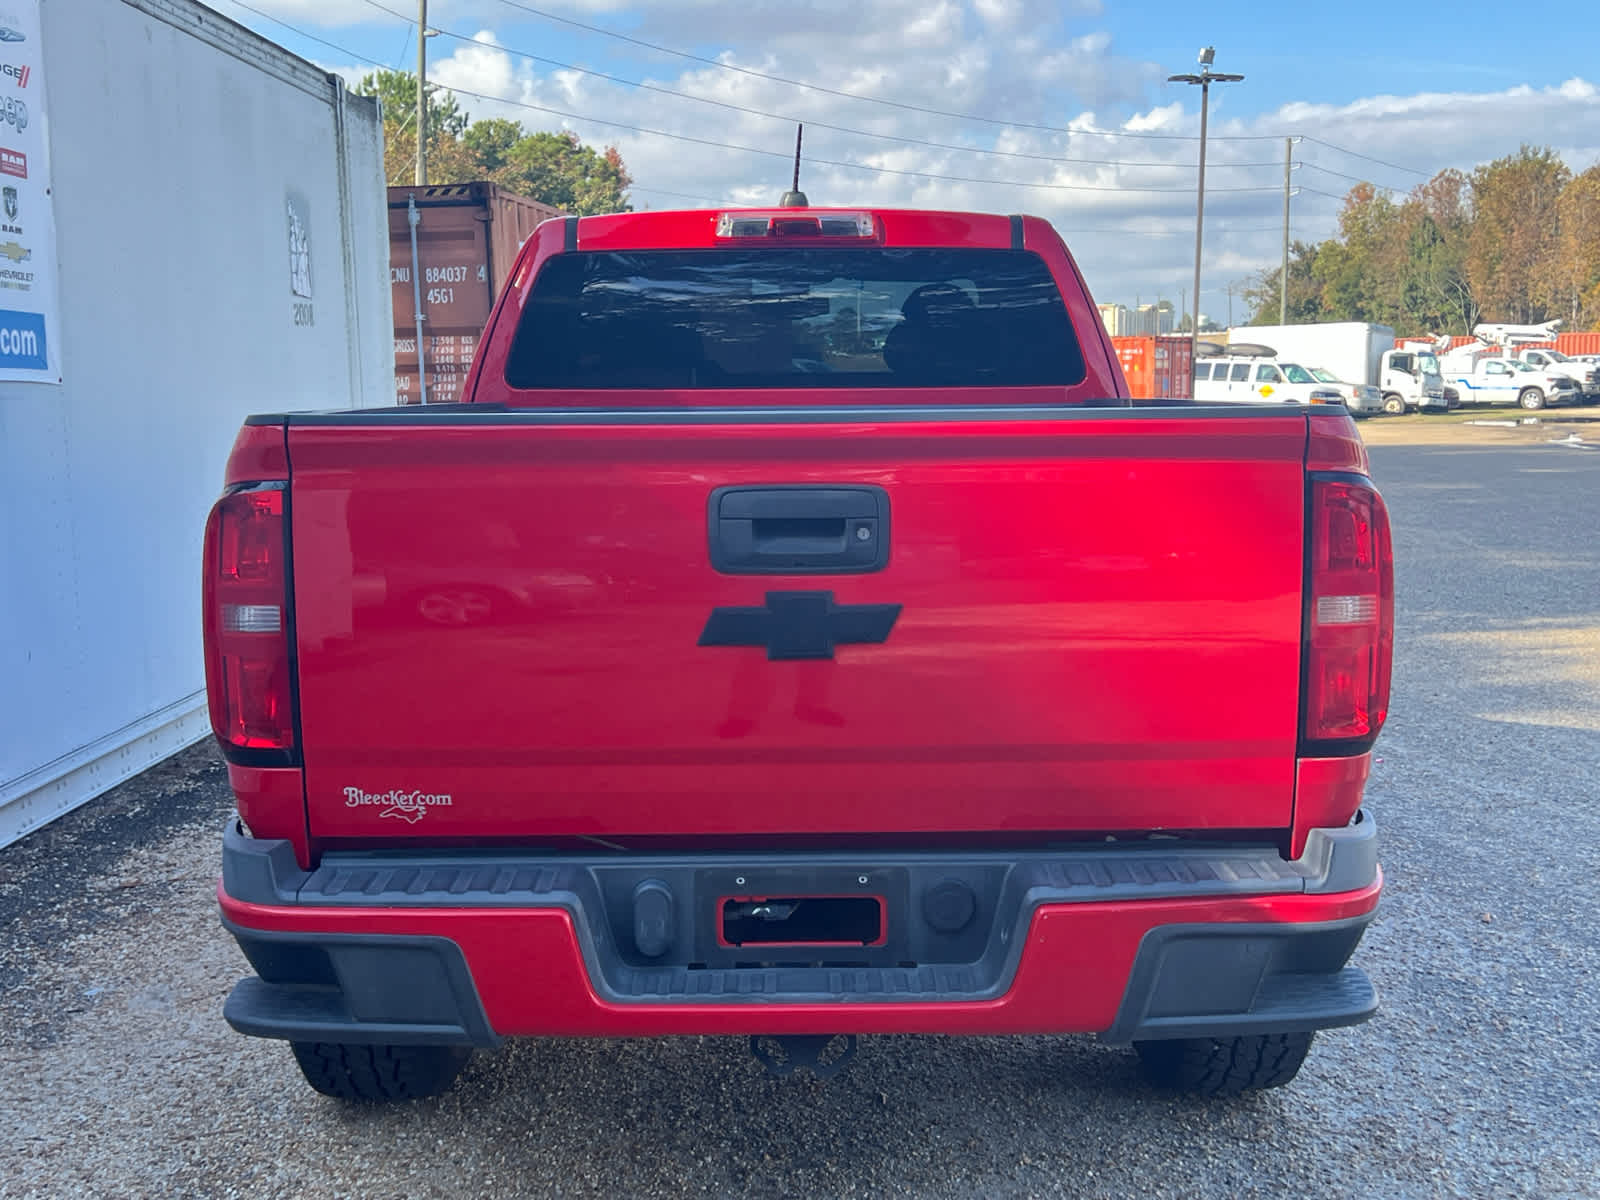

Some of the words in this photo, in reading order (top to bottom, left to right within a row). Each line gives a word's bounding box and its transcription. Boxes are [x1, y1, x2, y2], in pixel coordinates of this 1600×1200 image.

[0, 64, 23, 79] GE
[426, 266, 467, 283] 884037
[427, 288, 454, 304] 45G1
